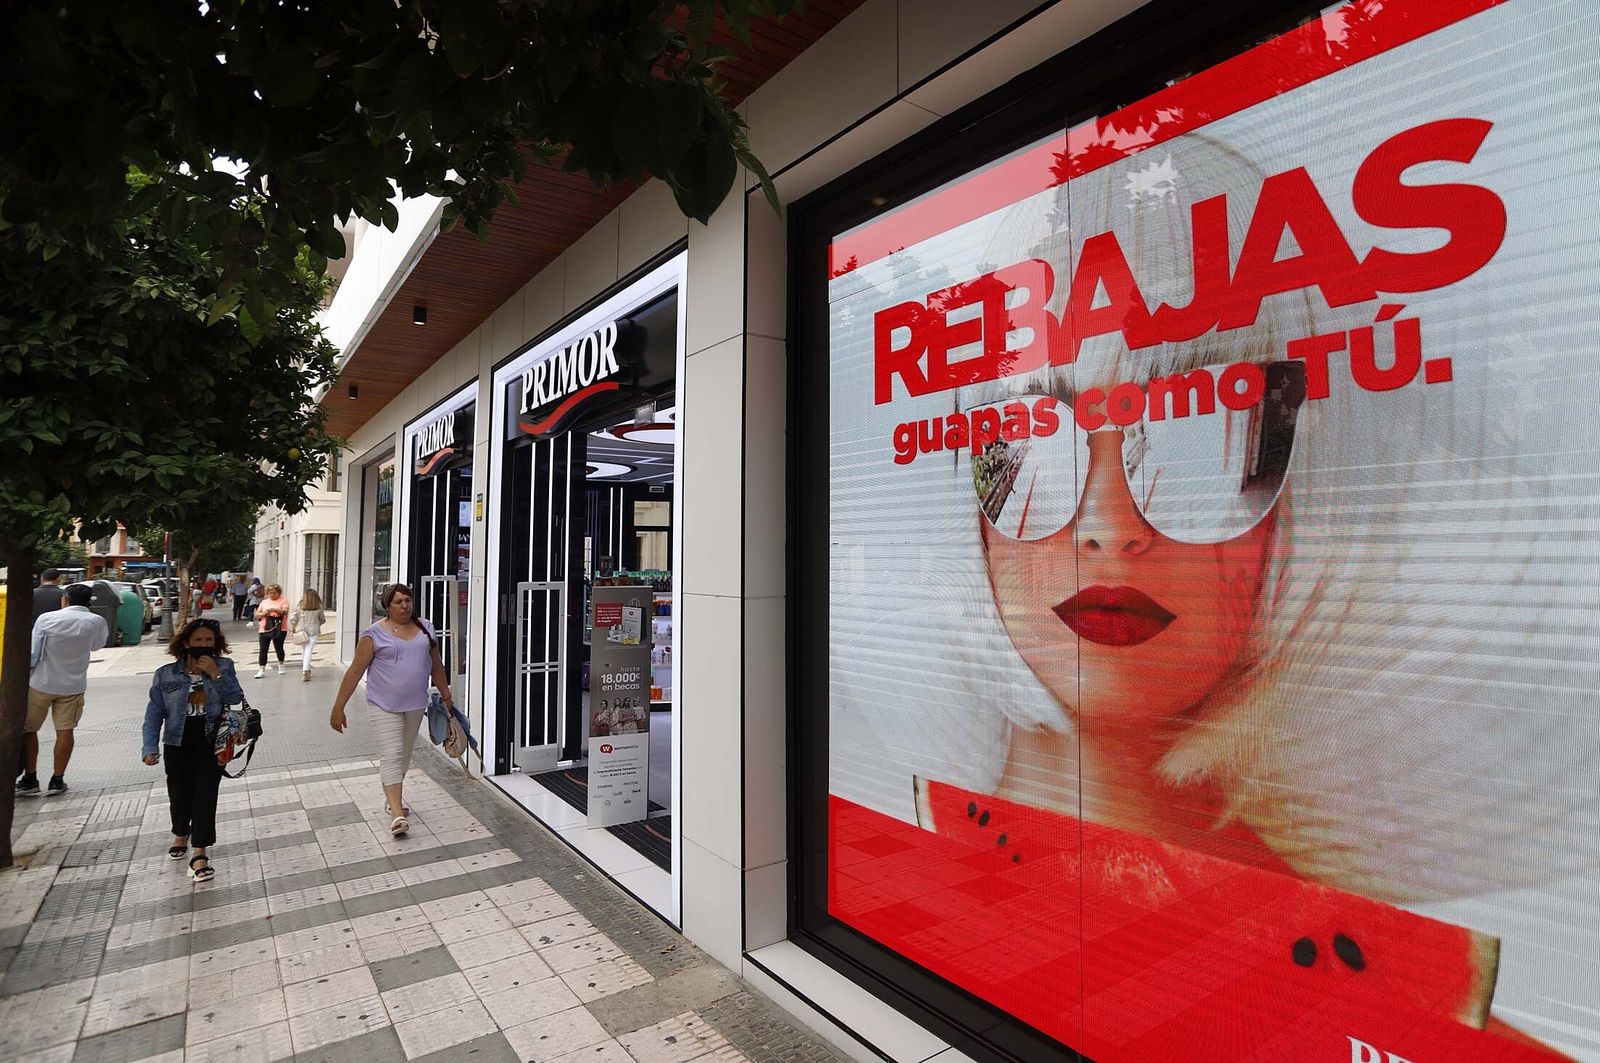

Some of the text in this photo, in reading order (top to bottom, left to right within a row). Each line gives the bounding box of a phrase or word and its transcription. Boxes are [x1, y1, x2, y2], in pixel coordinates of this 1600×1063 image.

[874, 116, 1508, 406] REBAJAS
[519, 320, 620, 415] PRIMOR
[892, 303, 1453, 465] guapas como TÚ.
[416, 411, 455, 461] PRIMOR
[600, 672, 641, 684] 18.000€
[601, 683, 640, 692] en becas
